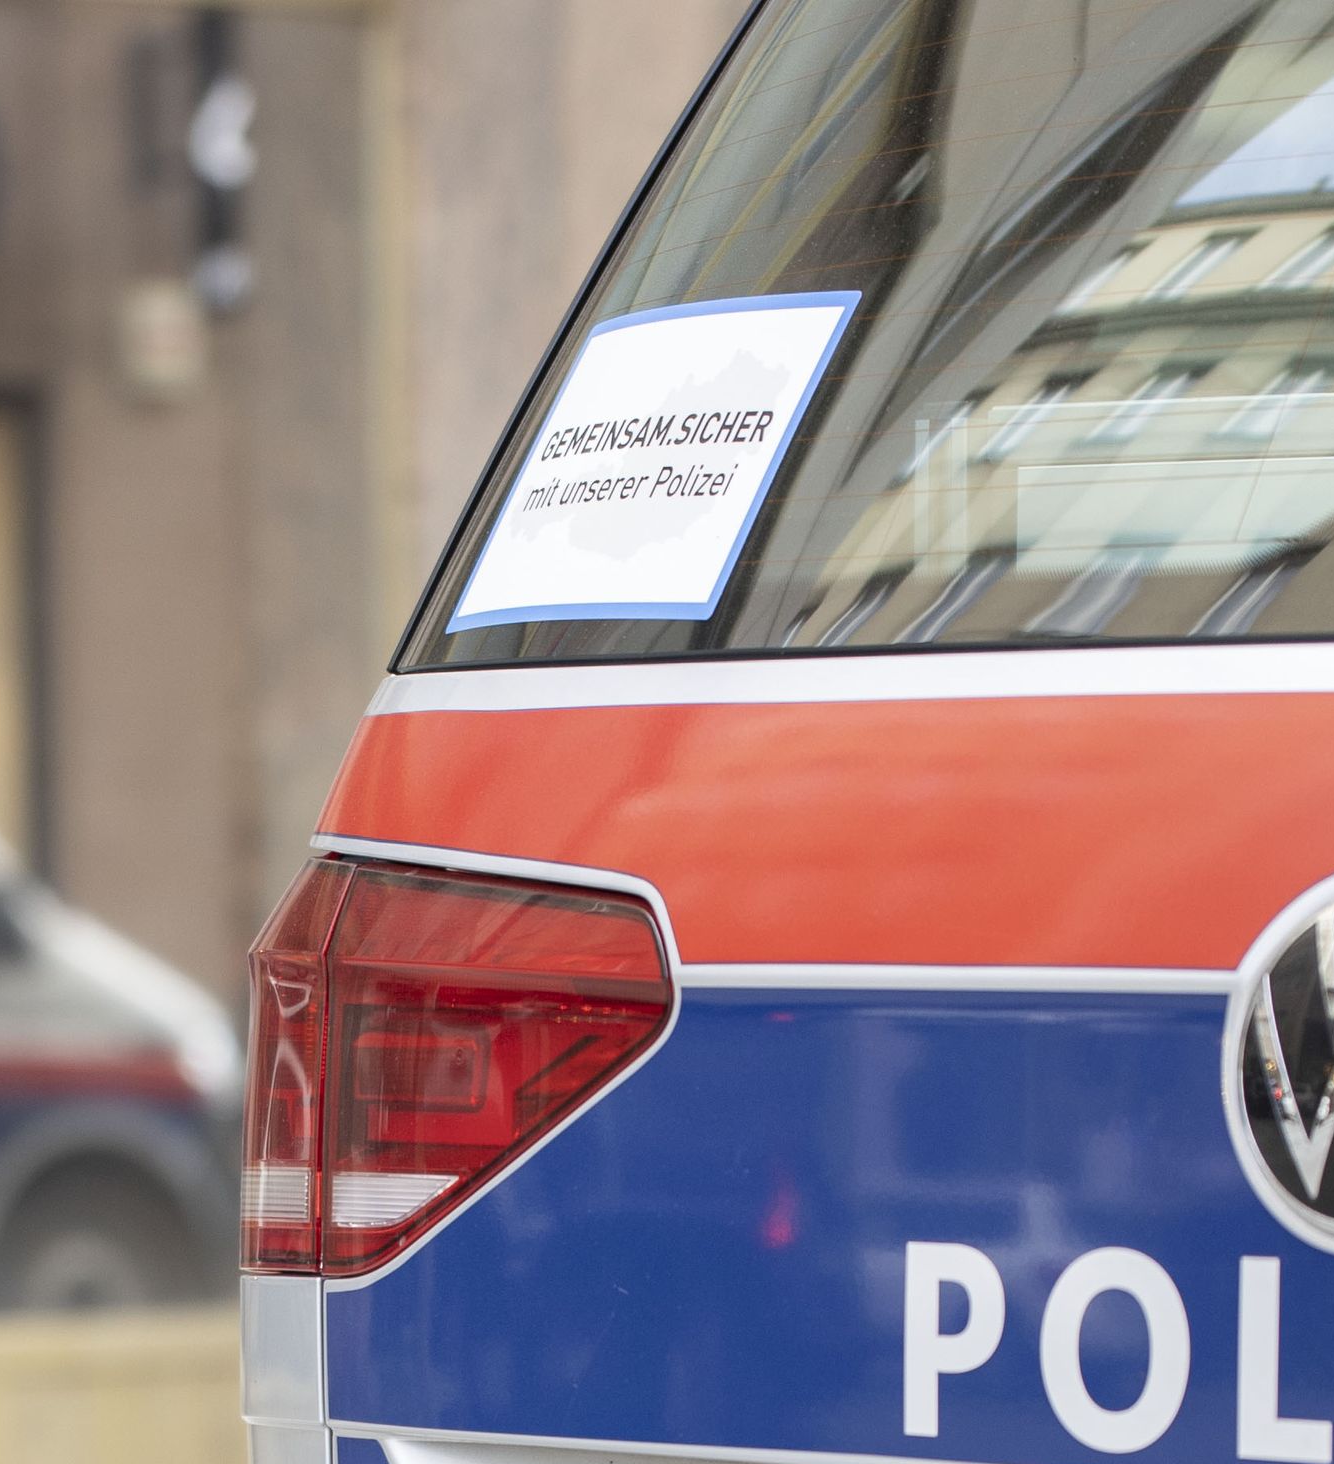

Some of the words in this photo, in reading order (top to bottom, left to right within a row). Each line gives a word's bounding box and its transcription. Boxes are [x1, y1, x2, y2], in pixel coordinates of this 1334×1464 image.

[541, 411, 774, 462] GEMEINSAM.SICHER
[523, 477, 561, 512] mit
[559, 475, 650, 505] unserer
[649, 463, 739, 499] Polizei
